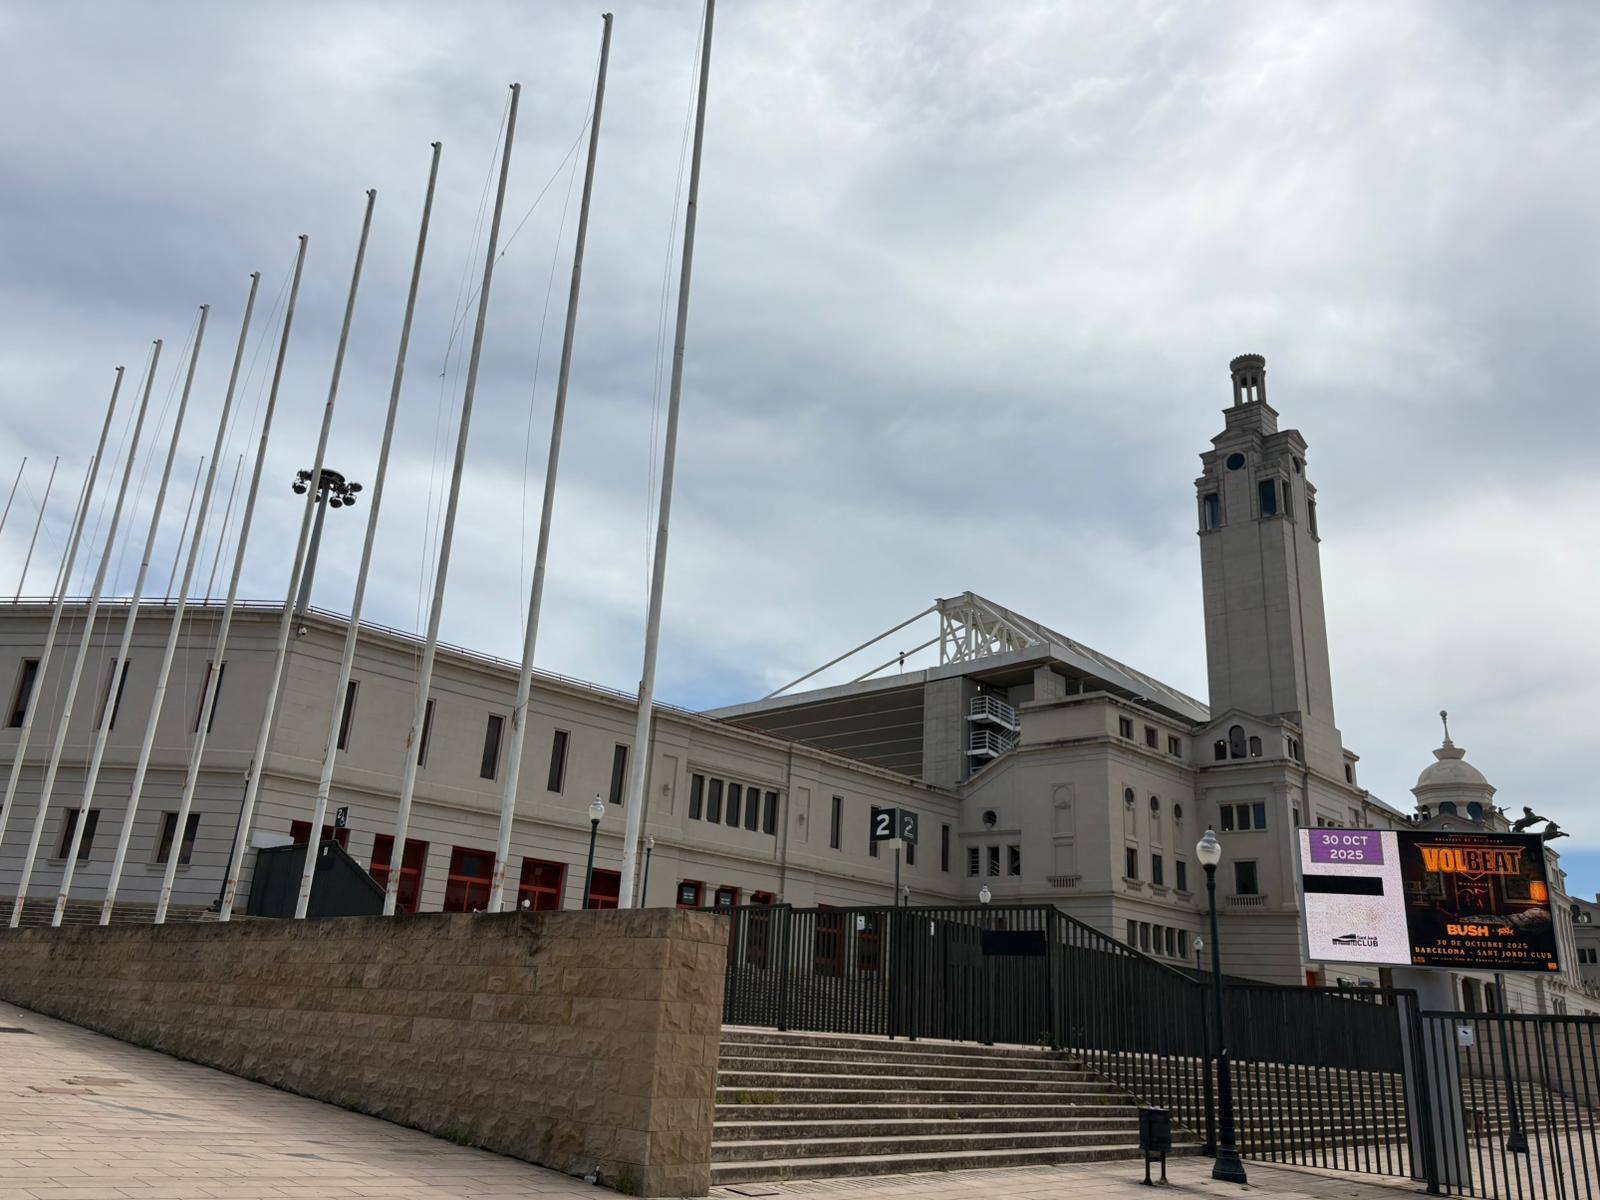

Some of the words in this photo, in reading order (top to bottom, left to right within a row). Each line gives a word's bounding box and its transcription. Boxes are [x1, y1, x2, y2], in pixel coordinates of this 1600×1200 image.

[876, 814, 890, 835] 2
[904, 816, 914, 838] 2
[1322, 835, 1339, 845] 30
[1343, 836, 1368, 846] OCT
[1330, 849, 1364, 860] 2025
[1422, 847, 1519, 873] VOLBEAT
[1446, 924, 1489, 936] BUSH
[1465, 940, 1503, 948] OCTUBRE
[1415, 946, 1466, 955] BARCELONA
